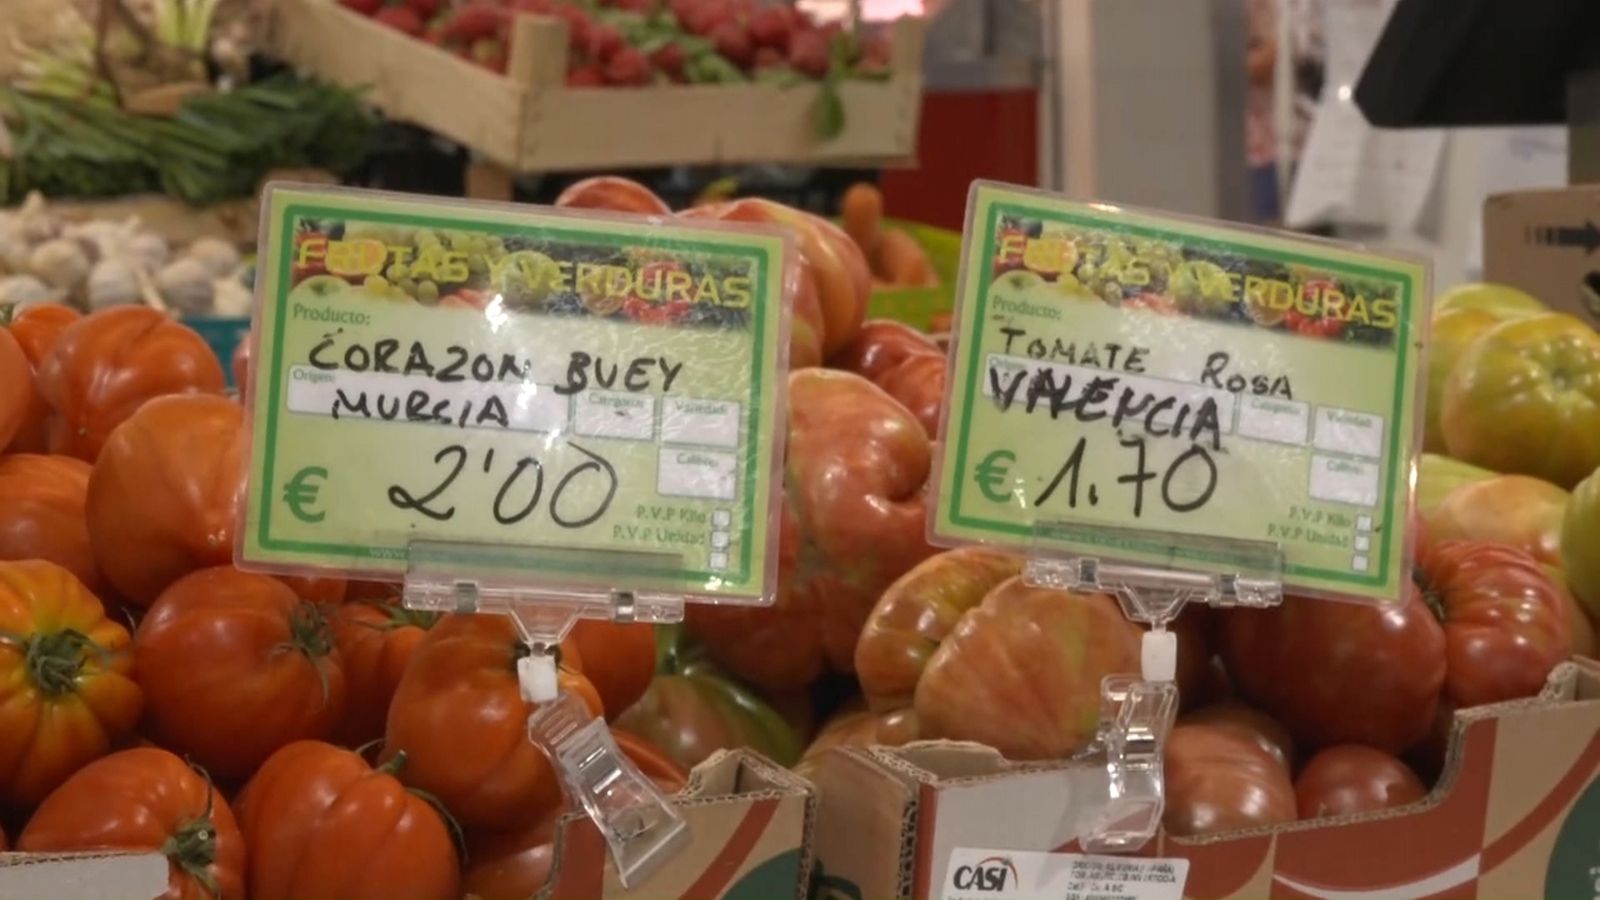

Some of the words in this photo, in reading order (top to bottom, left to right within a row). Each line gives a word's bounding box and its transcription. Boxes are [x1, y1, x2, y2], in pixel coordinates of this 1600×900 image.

[516, 254, 751, 309] VERDURAS
[992, 295, 1062, 321] Producto:
[1192, 262, 1397, 330] VERDURAS
[293, 304, 372, 326] Producto:
[309, 336, 531, 383] CORAZON
[554, 351, 682, 394] BUEY
[1000, 327, 1150, 374] TOMATE
[332, 388, 509, 428] MURCIA
[989, 366, 1221, 451] VALENCIA
[283, 465, 329, 523] €
[388, 441, 618, 529] 2'00
[973, 450, 1017, 502] €
[1033, 433, 1218, 518] 1.70
[953, 864, 1008, 892] CASI
